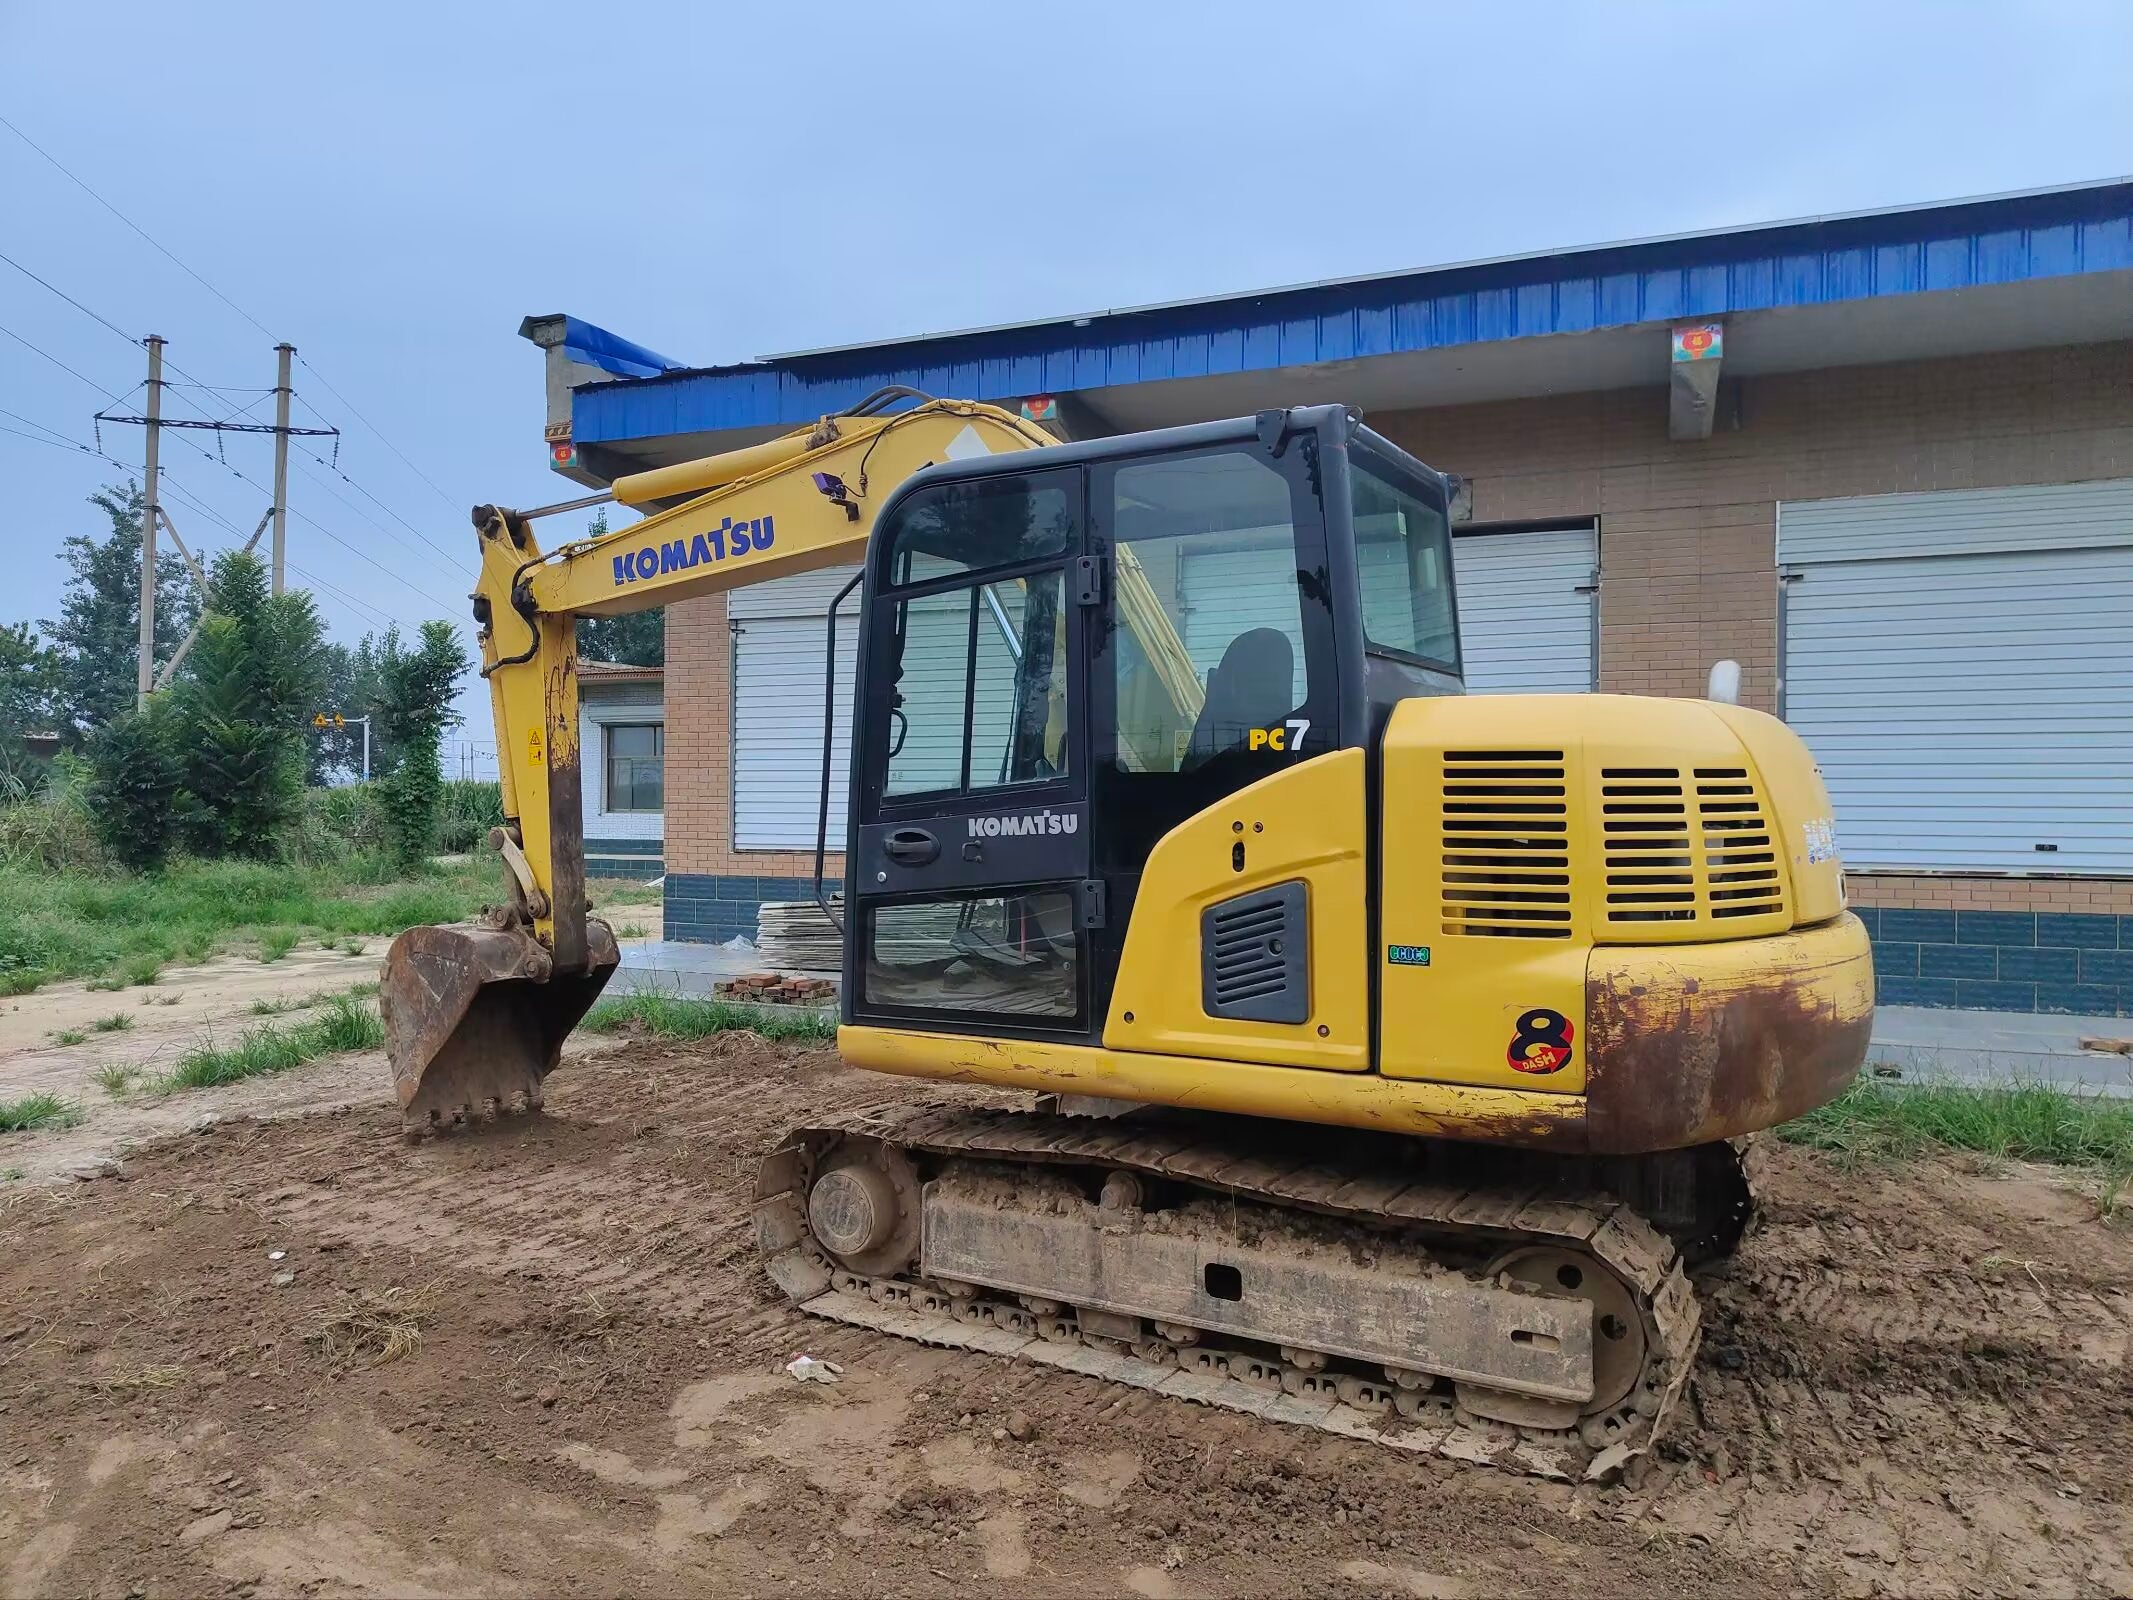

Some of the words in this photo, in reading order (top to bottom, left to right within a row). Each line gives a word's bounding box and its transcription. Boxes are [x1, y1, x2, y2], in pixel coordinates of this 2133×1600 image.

[612, 515, 775, 586] KOMATSU
[968, 809, 1078, 837] KOMATSU
[1509, 1008, 1573, 1074] 8
[1522, 1051, 1557, 1071] DASH
